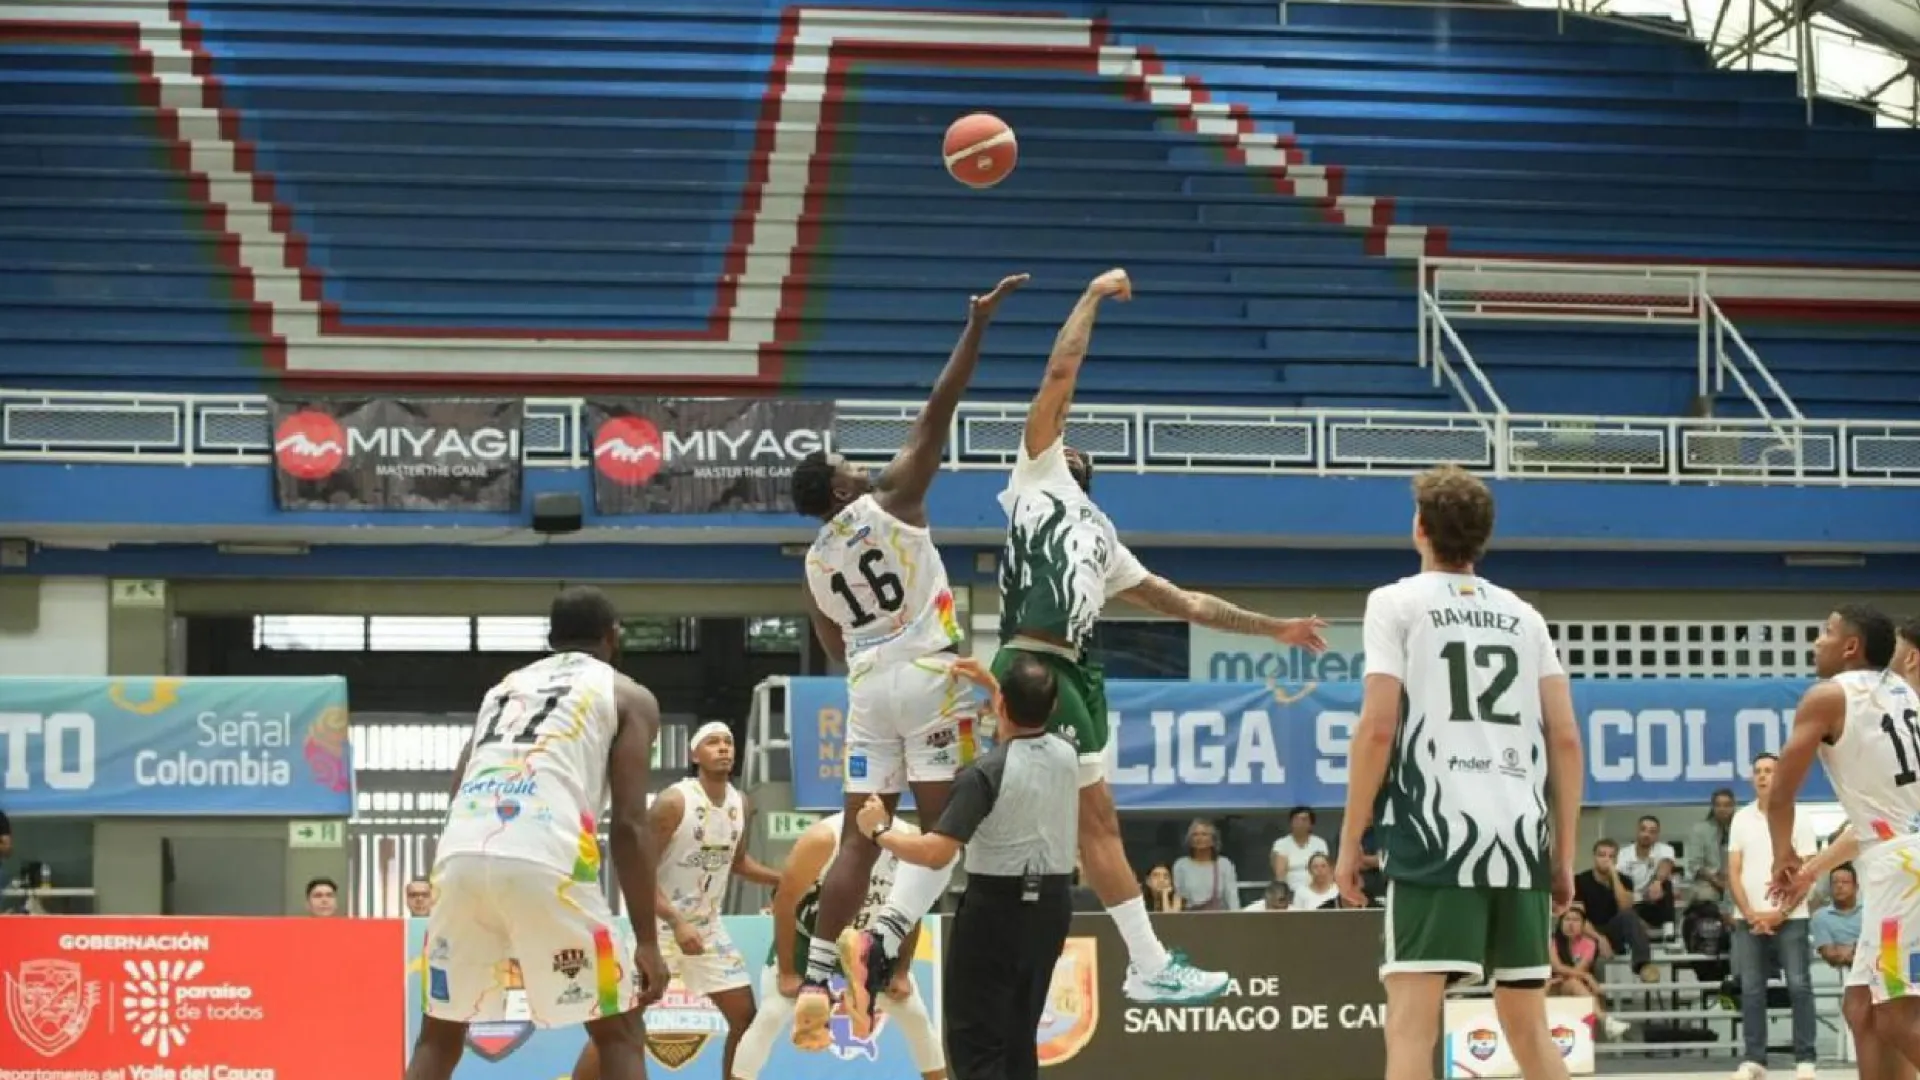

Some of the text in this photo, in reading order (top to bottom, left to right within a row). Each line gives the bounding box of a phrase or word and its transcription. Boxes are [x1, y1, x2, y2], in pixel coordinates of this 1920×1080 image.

[346, 426, 520, 458] MIYAGI
[662, 428, 831, 461] MIYAGI
[375, 463, 425, 478] MASTER
[693, 466, 742, 479] MASTER
[743, 466, 767, 478] THE
[830, 549, 905, 629] 16
[1427, 607, 1521, 637] RAMIREZ
[1439, 641, 1522, 725] 12
[196, 711, 291, 748] Señal
[477, 685, 572, 748] 17
[0, 712, 95, 790] TO
[1107, 711, 1286, 785] LIGA
[1589, 709, 1795, 783] COLO
[134, 750, 291, 787] Colombia
[59, 932, 210, 951] GOBERNACIÓN
[1249, 977, 1280, 996] DE
[176, 1002, 264, 1020] de todos
[1124, 1005, 1281, 1033] SANTIAGO
[1291, 1004, 1329, 1030] DE
[129, 1064, 177, 1080] Valle
[180, 1064, 209, 1080] del
[213, 1064, 276, 1080] Cauca
